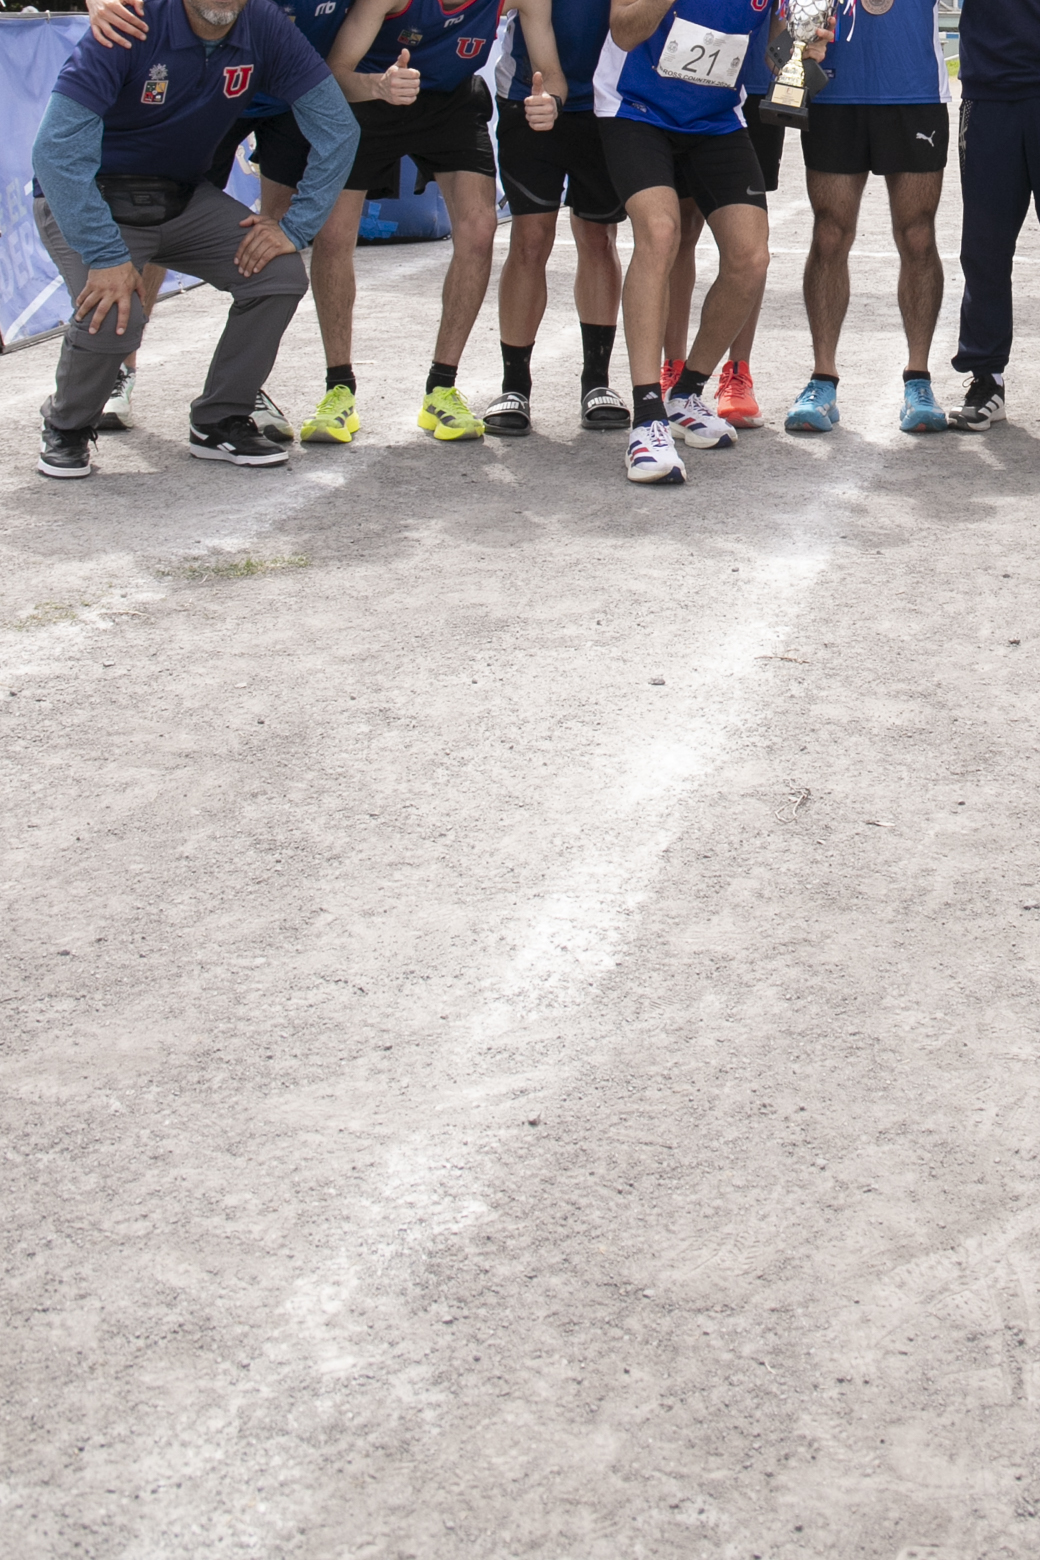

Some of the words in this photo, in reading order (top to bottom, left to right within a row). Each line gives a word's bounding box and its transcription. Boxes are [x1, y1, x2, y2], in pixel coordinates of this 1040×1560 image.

[456, 37, 486, 59] U
[681, 44, 721, 76] 21
[223, 64, 254, 99] U
